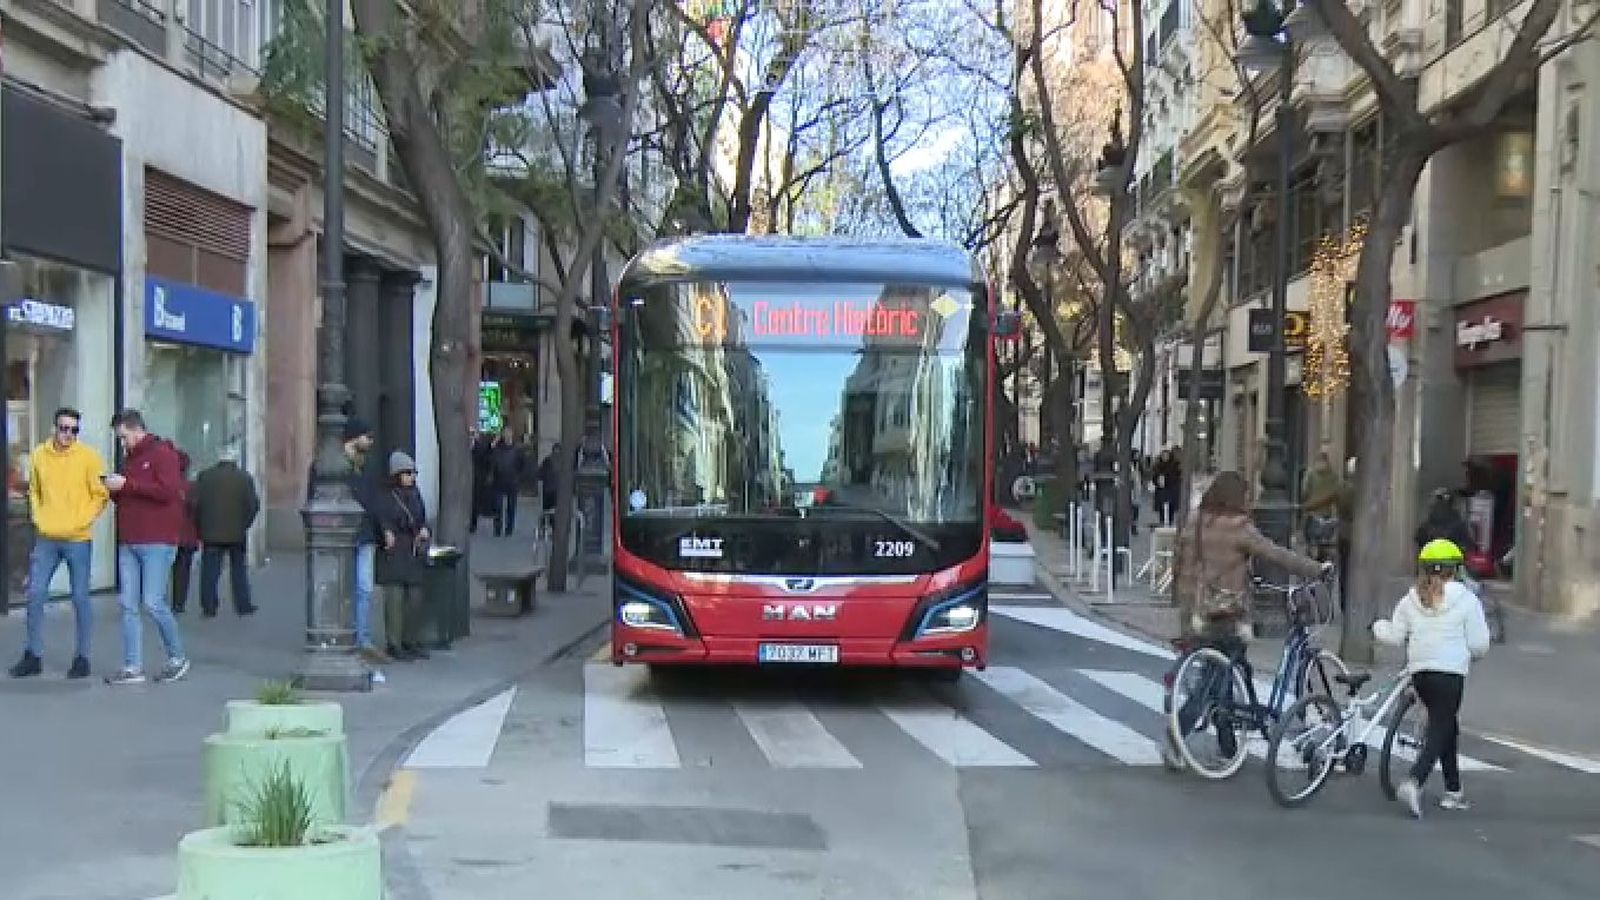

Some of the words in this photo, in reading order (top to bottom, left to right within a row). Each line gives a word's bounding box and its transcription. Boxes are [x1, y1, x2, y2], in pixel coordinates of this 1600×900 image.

[754, 301, 829, 336] Centre
[680, 537, 723, 551] EMT
[874, 541, 915, 557] 2209
[763, 604, 836, 621] MAN
